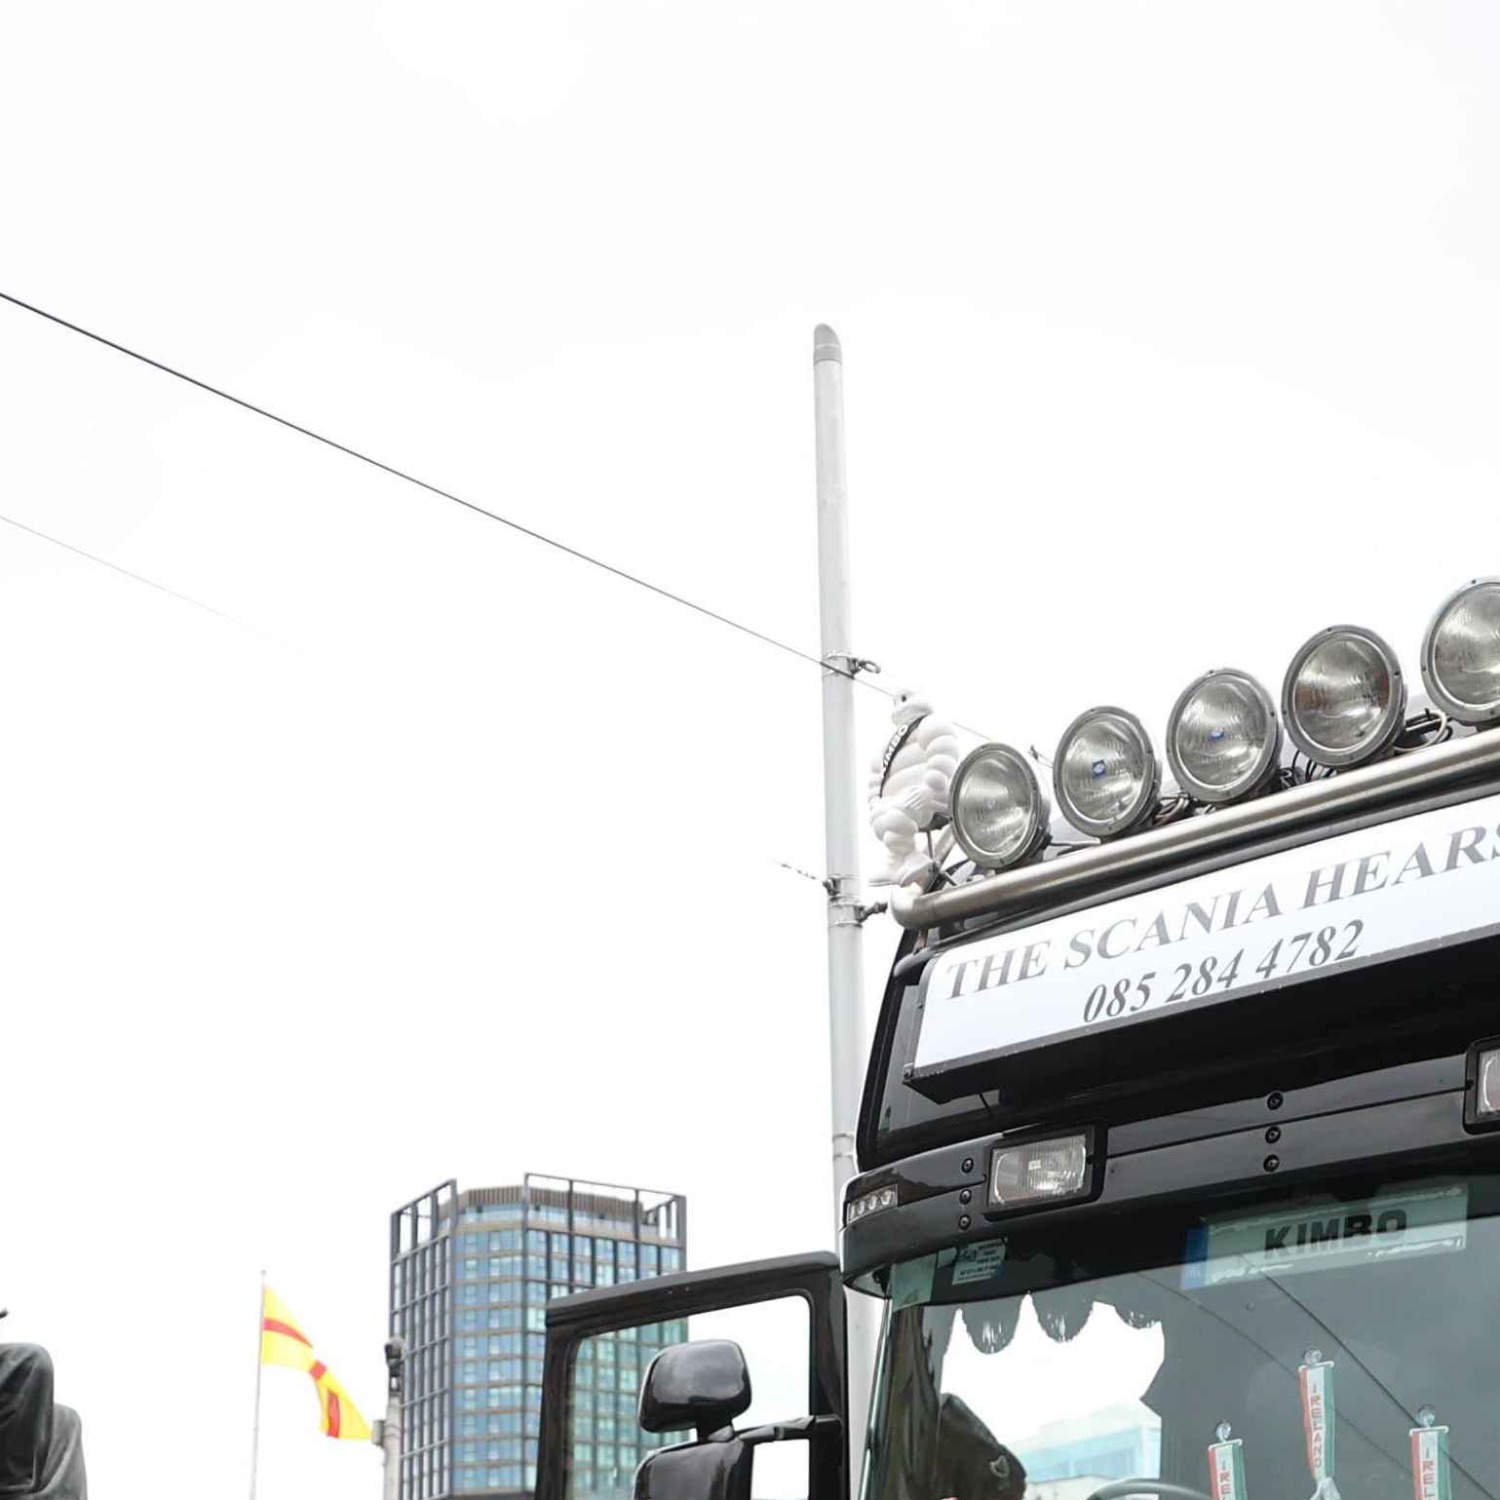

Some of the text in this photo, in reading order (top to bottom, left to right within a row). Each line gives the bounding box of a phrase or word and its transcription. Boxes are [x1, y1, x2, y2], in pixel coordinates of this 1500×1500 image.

[882, 724, 909, 772] IMBO
[946, 938, 1054, 1000] THE
[1063, 882, 1284, 970] SCANIA
[1083, 919, 1364, 1023] 085 284 4782
[1264, 1209, 1408, 1256] KIMBO
[1310, 1382, 1323, 1468] IRELAND
